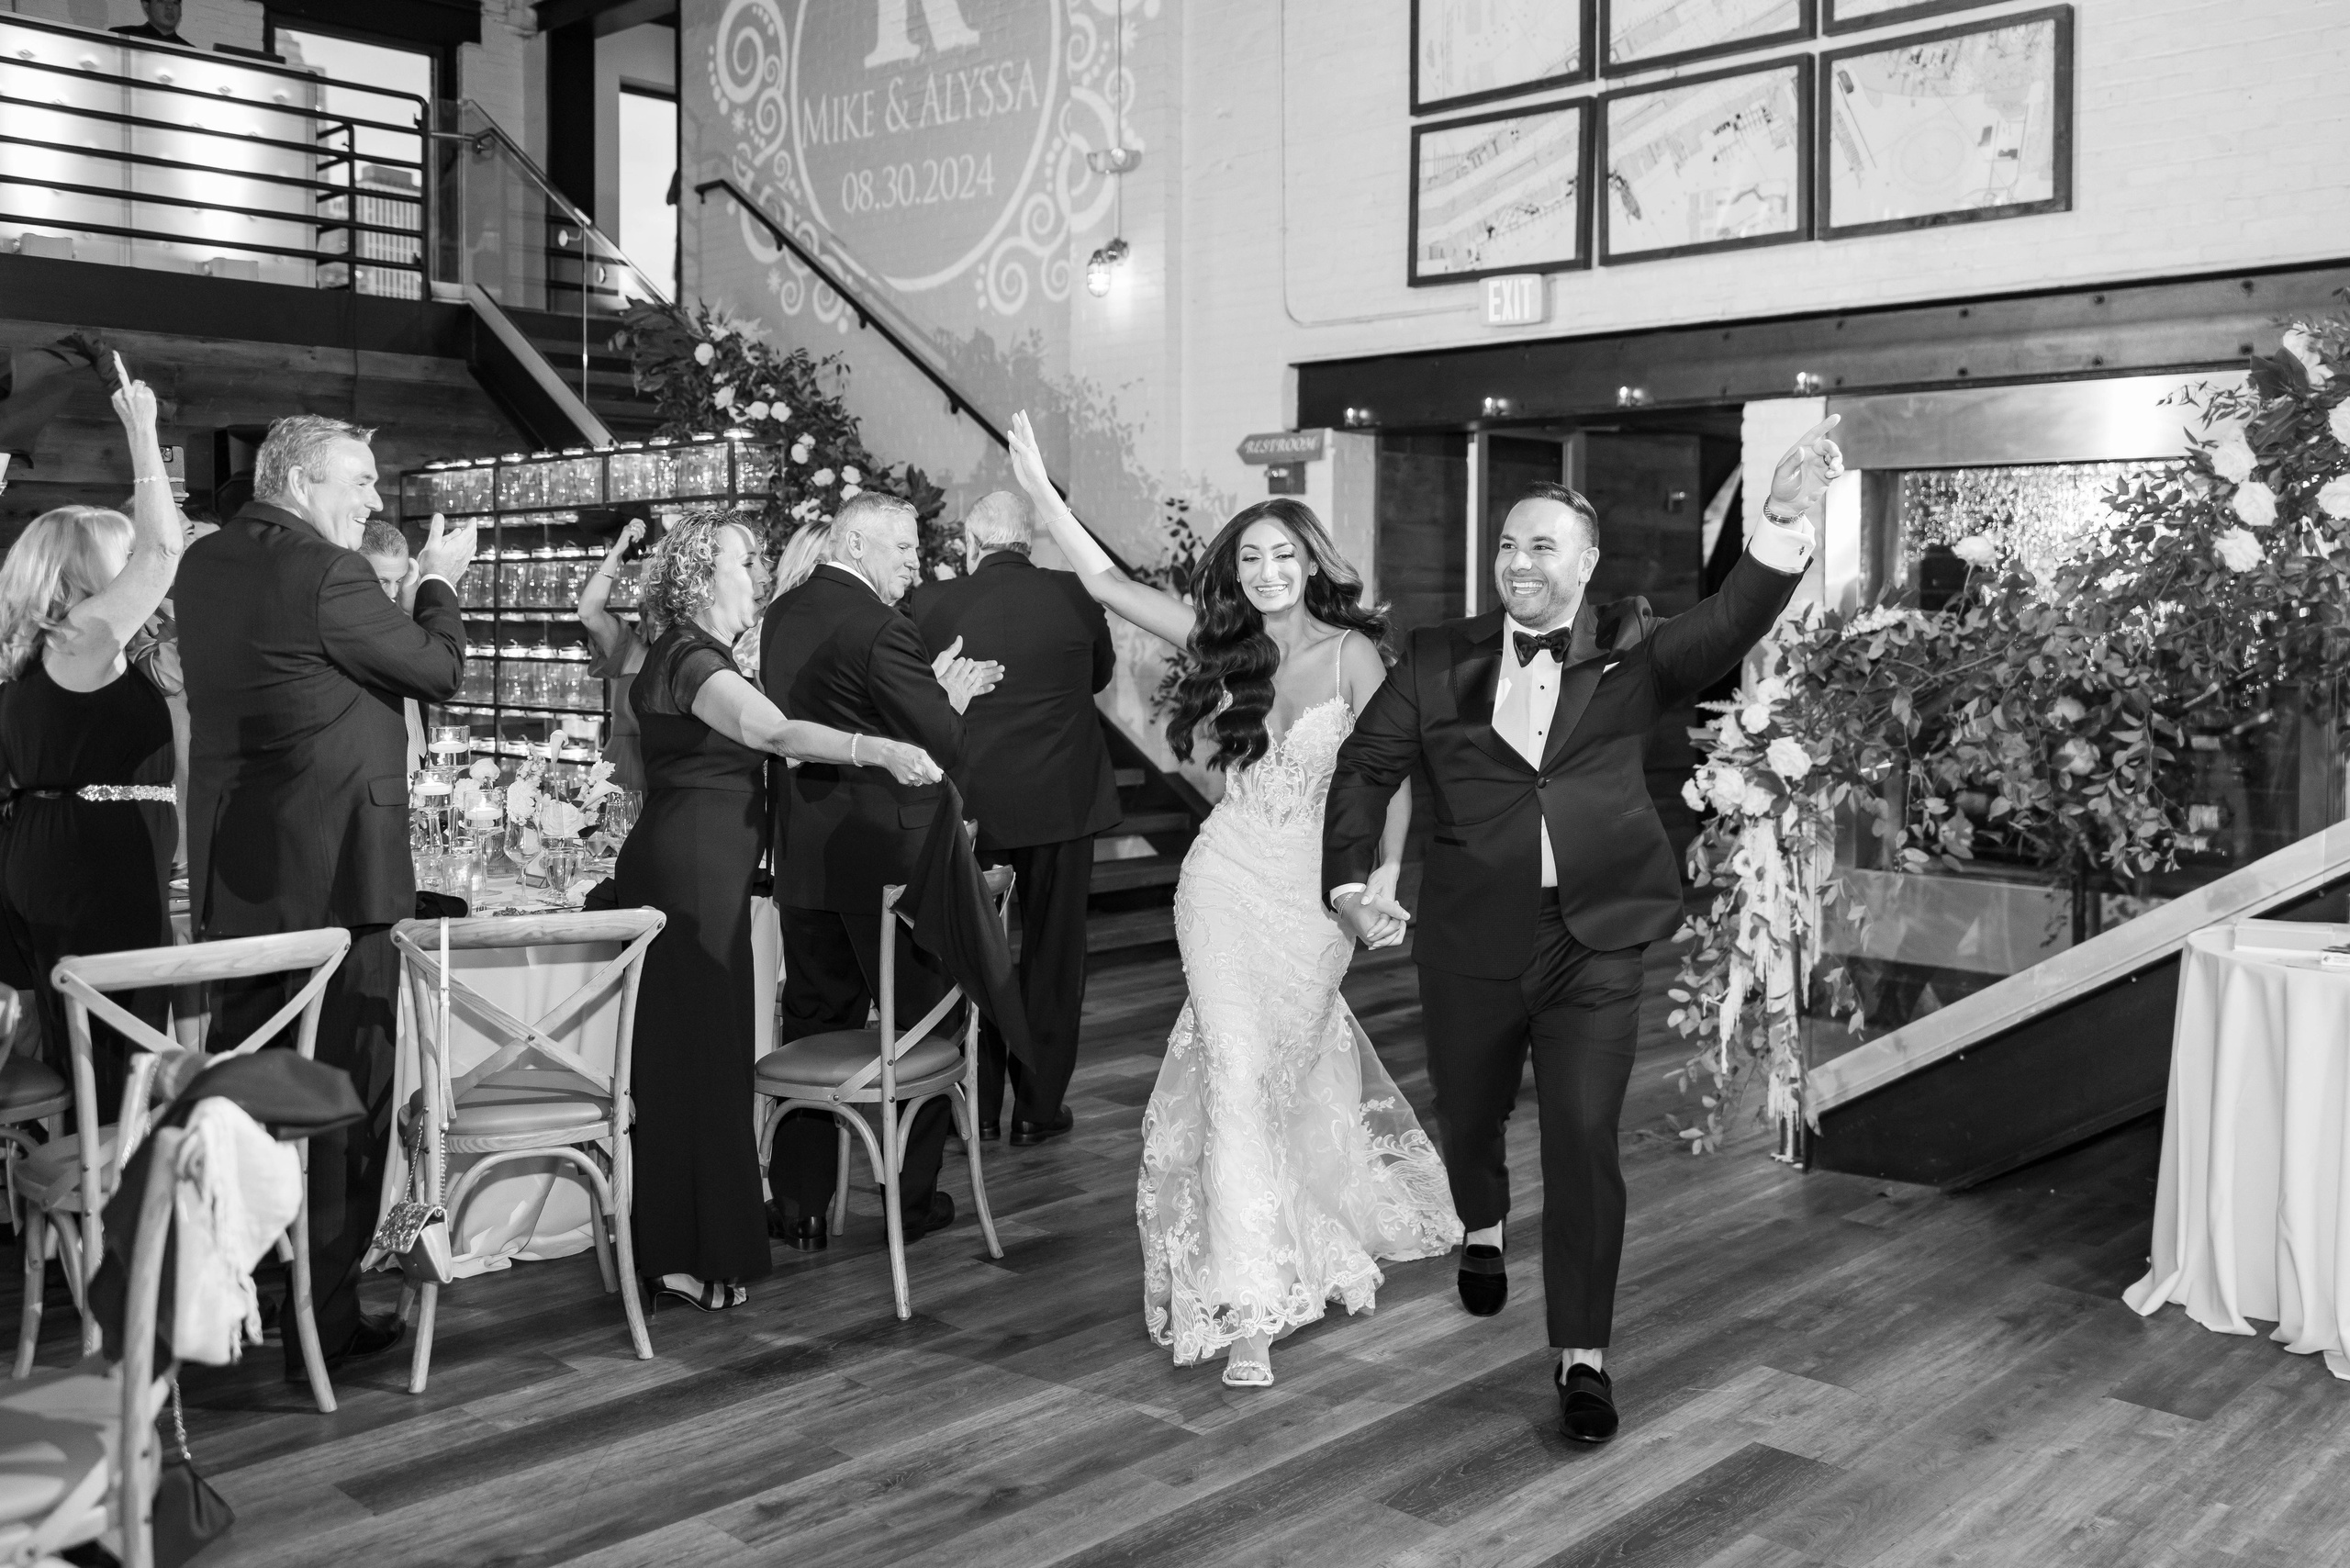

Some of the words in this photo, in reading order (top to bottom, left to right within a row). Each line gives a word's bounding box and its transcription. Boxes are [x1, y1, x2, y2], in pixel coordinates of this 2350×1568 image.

[802, 91, 874, 148] MIKE
[885, 76, 912, 132] &
[919, 58, 1039, 128] ALYSSA
[842, 152, 994, 212] 08.30.2024
[1488, 278, 1533, 322] EXIT
[1245, 437, 1316, 454] RESTROOM
